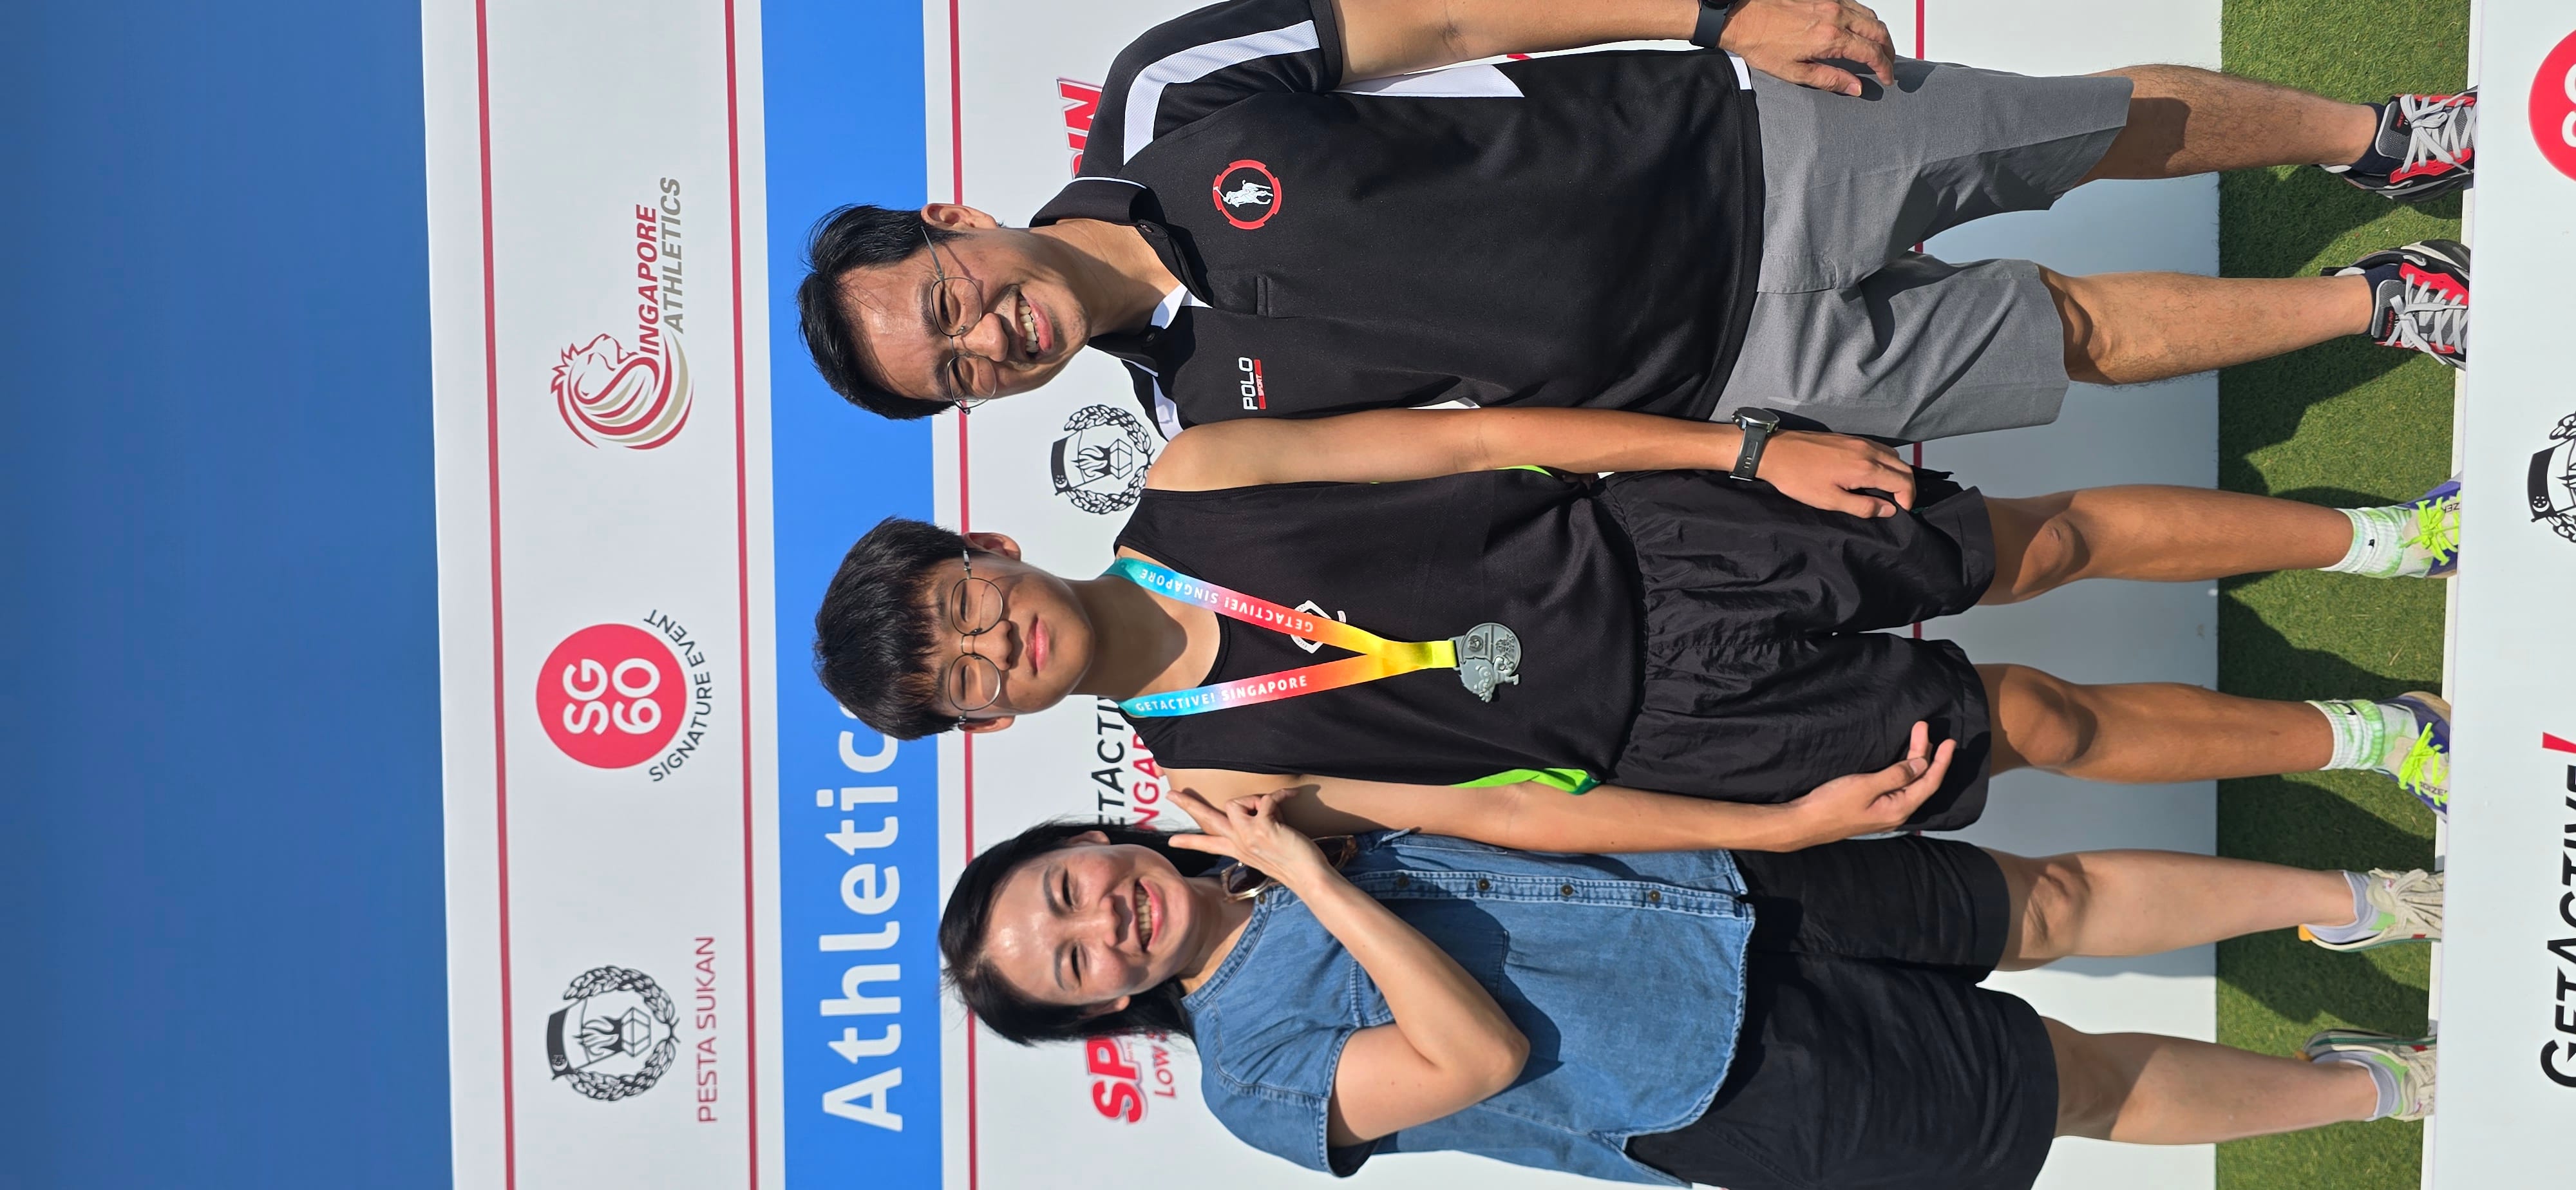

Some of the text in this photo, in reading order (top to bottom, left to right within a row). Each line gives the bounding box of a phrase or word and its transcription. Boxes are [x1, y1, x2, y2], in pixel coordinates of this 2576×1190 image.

[660, 177, 684, 335] ATHLETICS
[1238, 357, 1258, 410] POLO
[1255, 373, 1264, 397] SPORT
[1139, 569, 1313, 632] GETACTIVE! SINGAPORE
[562, 658, 609, 735] SG
[612, 657, 662, 734] 60
[643, 609, 712, 782] SIGNATURE EVENT
[1135, 675, 1307, 712] GETACTIVE! SINGAPORE
[816, 702, 904, 1131] Athletic
[695, 937, 717, 1122] PESTA SUKAN
[1152, 1046, 1176, 1098] LOW
